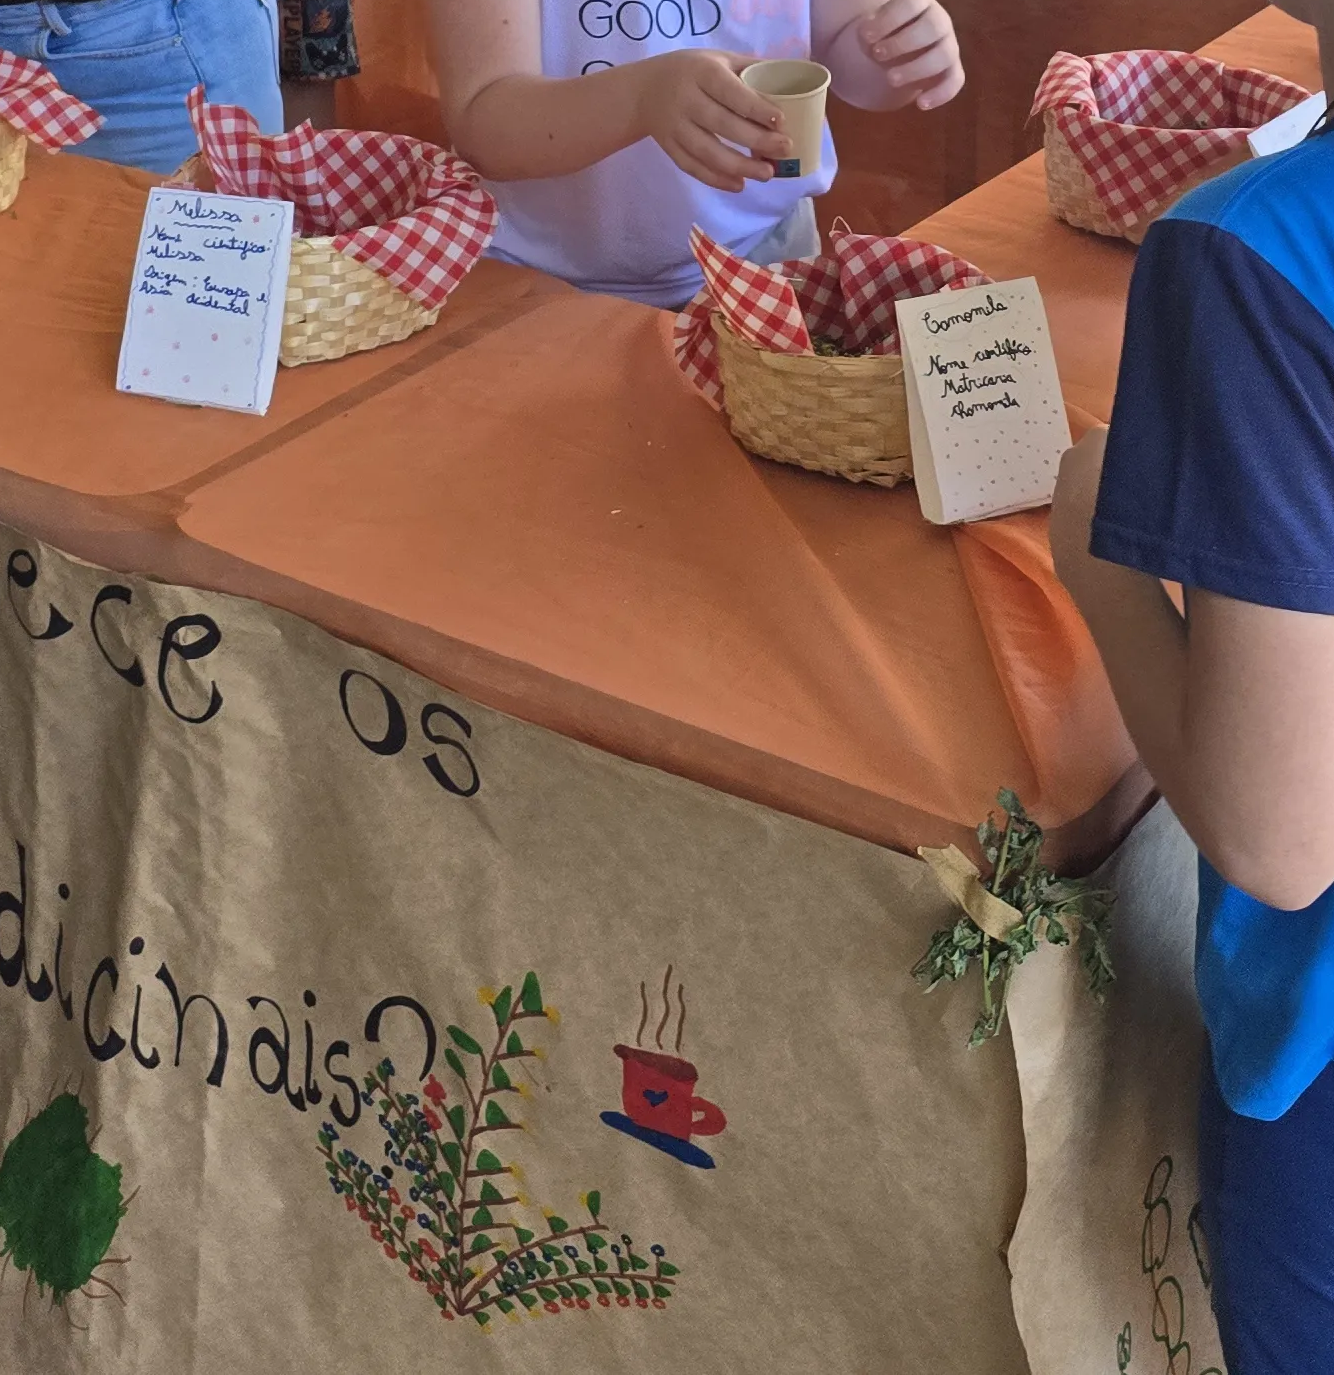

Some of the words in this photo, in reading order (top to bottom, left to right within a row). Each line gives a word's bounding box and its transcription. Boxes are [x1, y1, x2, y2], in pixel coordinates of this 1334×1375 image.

[167, 196, 243, 224] Melissa
[146, 242, 206, 262] Melissa
[256, 292, 268, 304] e
[923, 354, 970, 377] Nome
[339, 668, 481, 797] os
